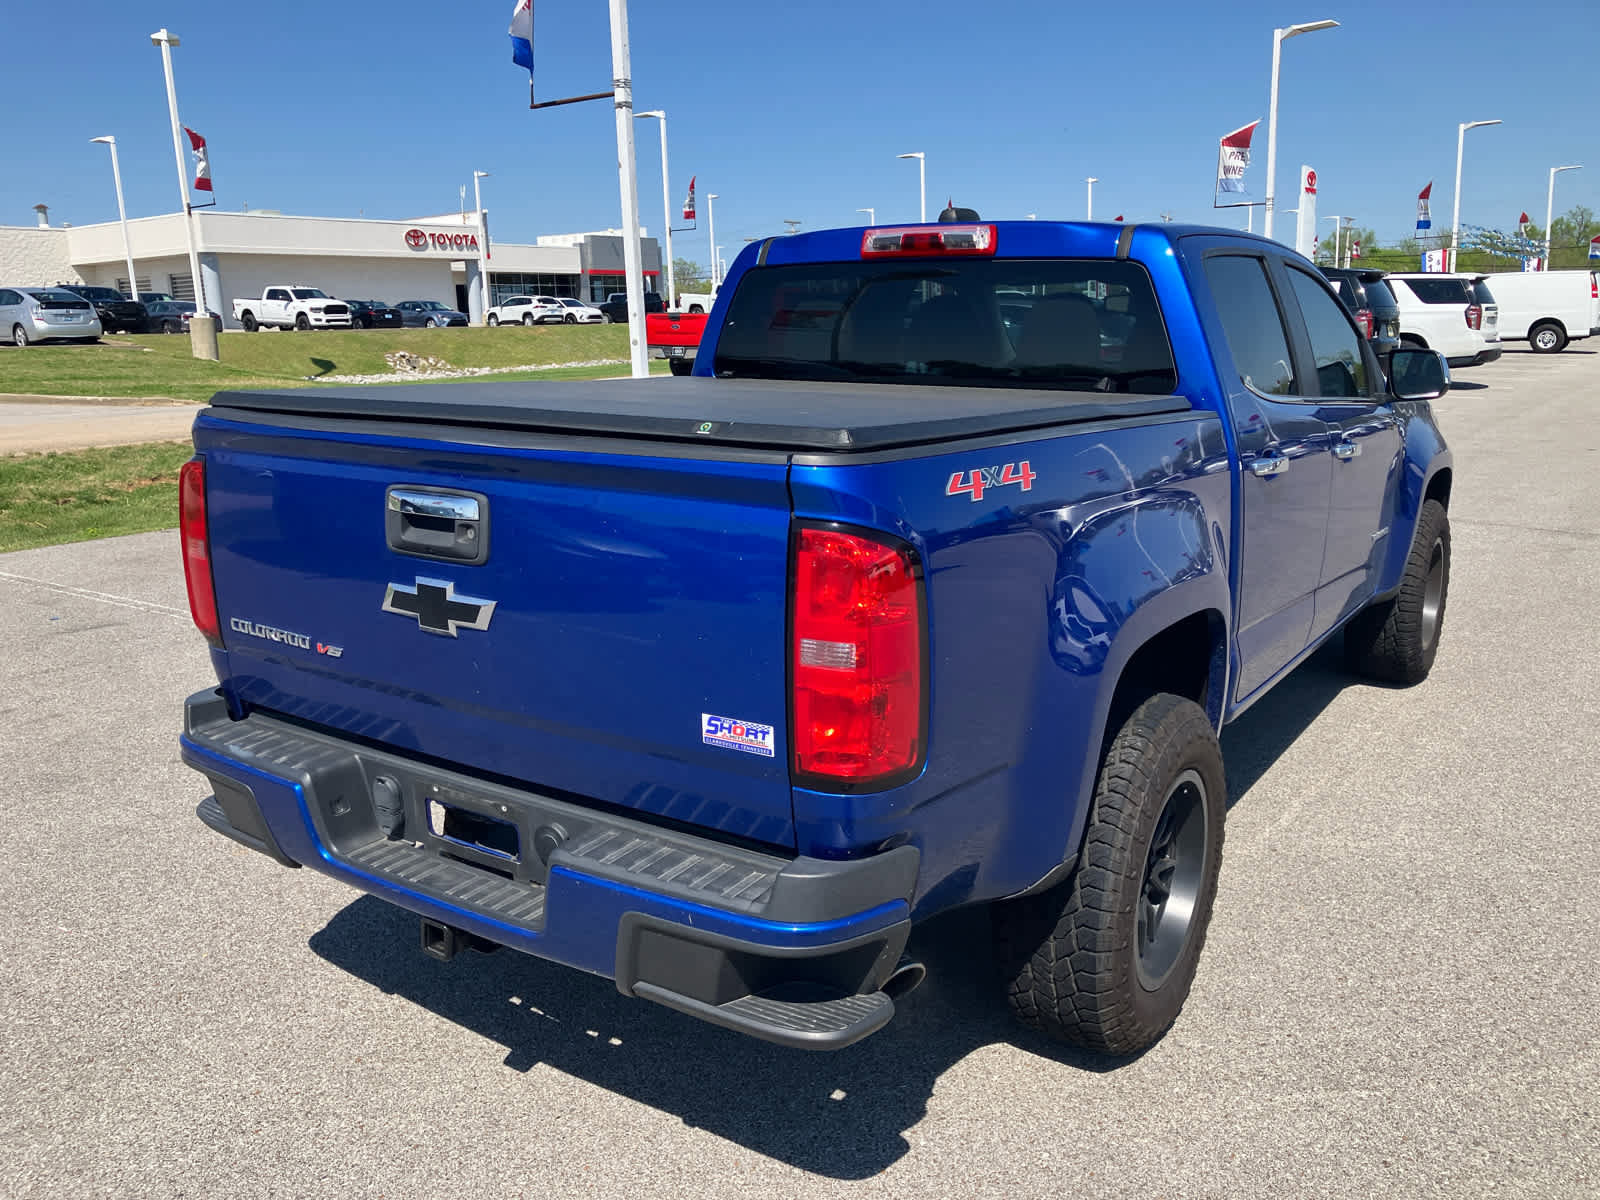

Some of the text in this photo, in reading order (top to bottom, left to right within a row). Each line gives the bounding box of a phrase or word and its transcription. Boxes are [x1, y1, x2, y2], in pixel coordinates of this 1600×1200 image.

[428, 233, 478, 247] TOYOTA
[230, 617, 311, 649] COLORADO
[705, 715, 770, 741] SHORT
